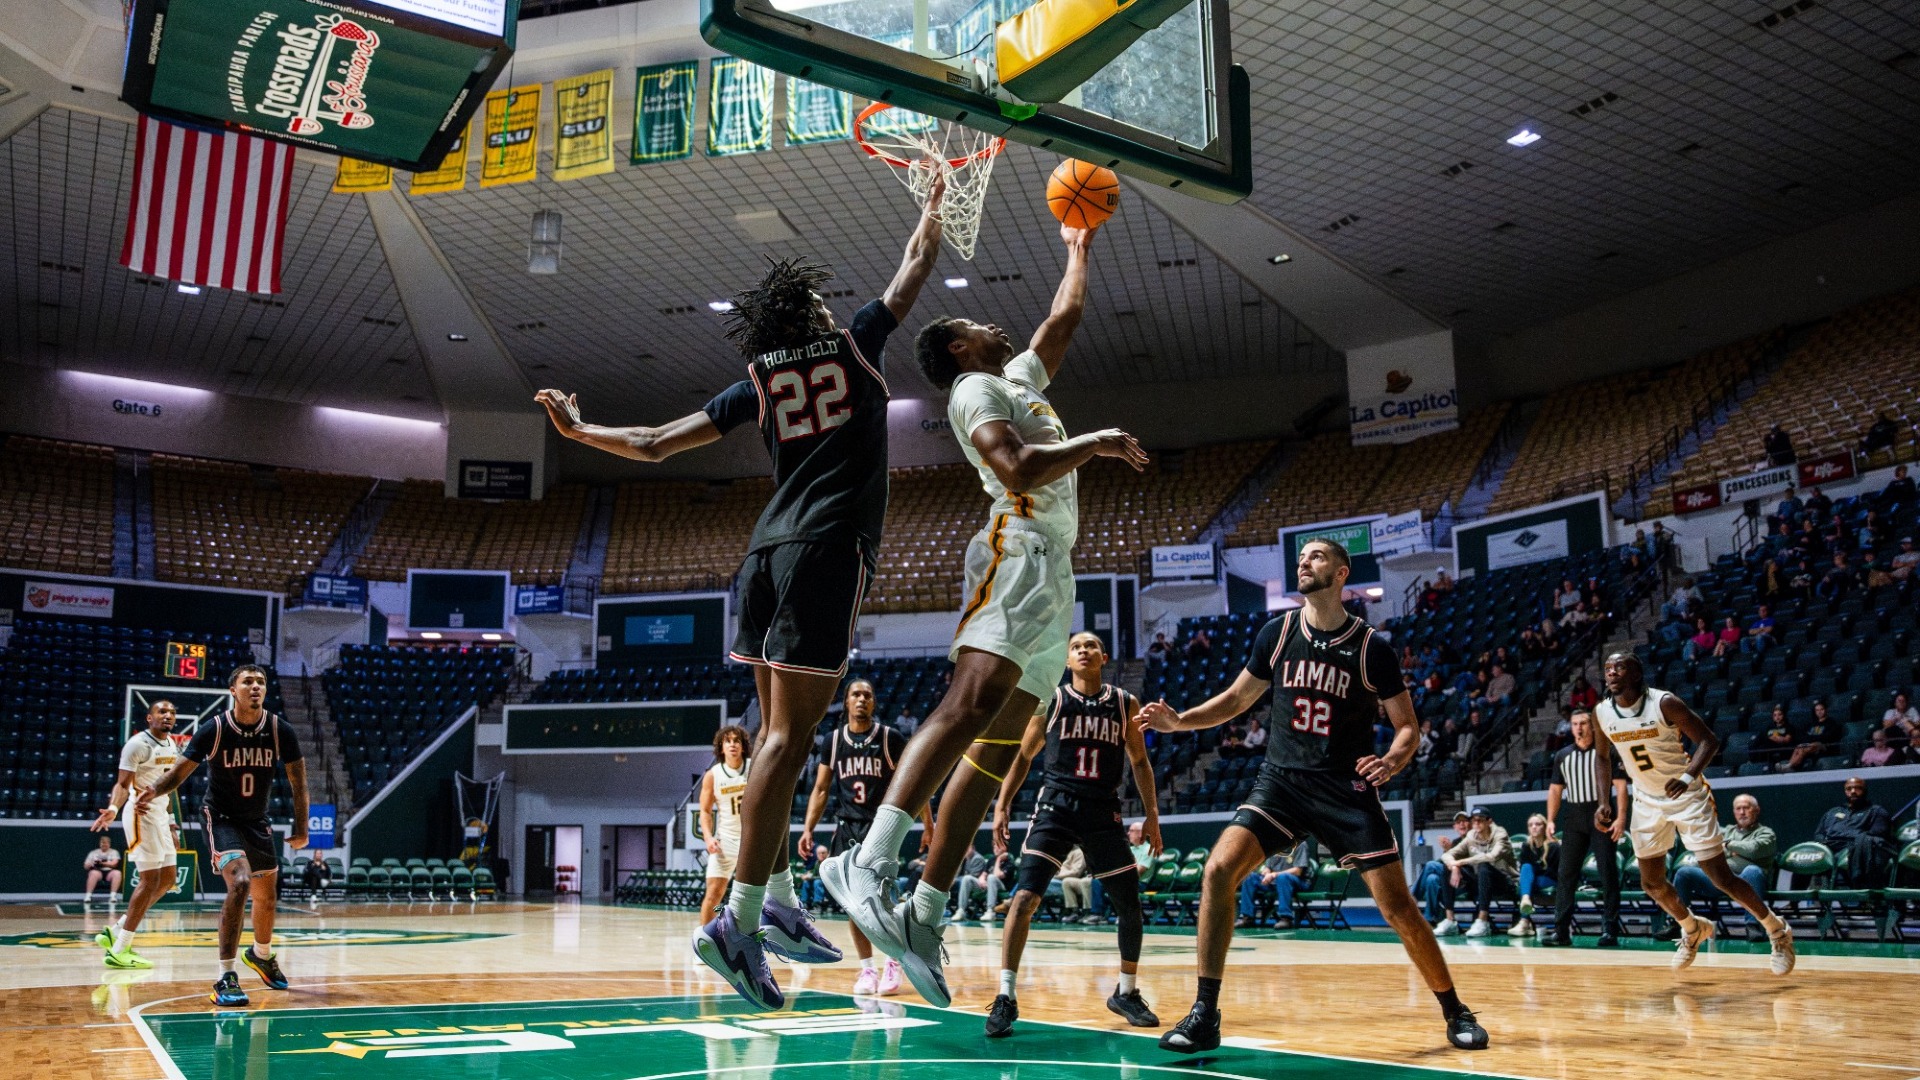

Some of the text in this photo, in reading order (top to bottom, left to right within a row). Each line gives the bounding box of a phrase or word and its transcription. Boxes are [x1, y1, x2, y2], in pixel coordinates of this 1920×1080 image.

[227, 11, 279, 114] TANGIPAHOA PARISH
[255, 23, 321, 118] Crossroads
[560, 117, 604, 138] SLU
[763, 340, 839, 370] HOLIFIELD
[113, 399, 162, 416] Gate 6
[768, 361, 852, 443] 22
[1350, 388, 1459, 423] La Capitol
[1726, 469, 1793, 495] CONCESSIONS
[1300, 529, 1363, 546] CURTYARD
[1374, 517, 1419, 539] La Capitol
[1155, 550, 1211, 563] La Capitol
[176, 644, 205, 657] 7:56
[180, 658, 198, 677] 15
[1282, 659, 1351, 699] LAMAR
[1292, 696, 1332, 737] 32
[1059, 714, 1121, 746] LAMAR
[223, 747, 274, 768] LAMAR
[837, 756, 883, 780] LAMAR
[1075, 746, 1100, 779] 11
[1629, 744, 1655, 773] 5
[241, 772, 256, 798] 0
[852, 781, 866, 804] 3
[1785, 851, 1826, 863] Lions
